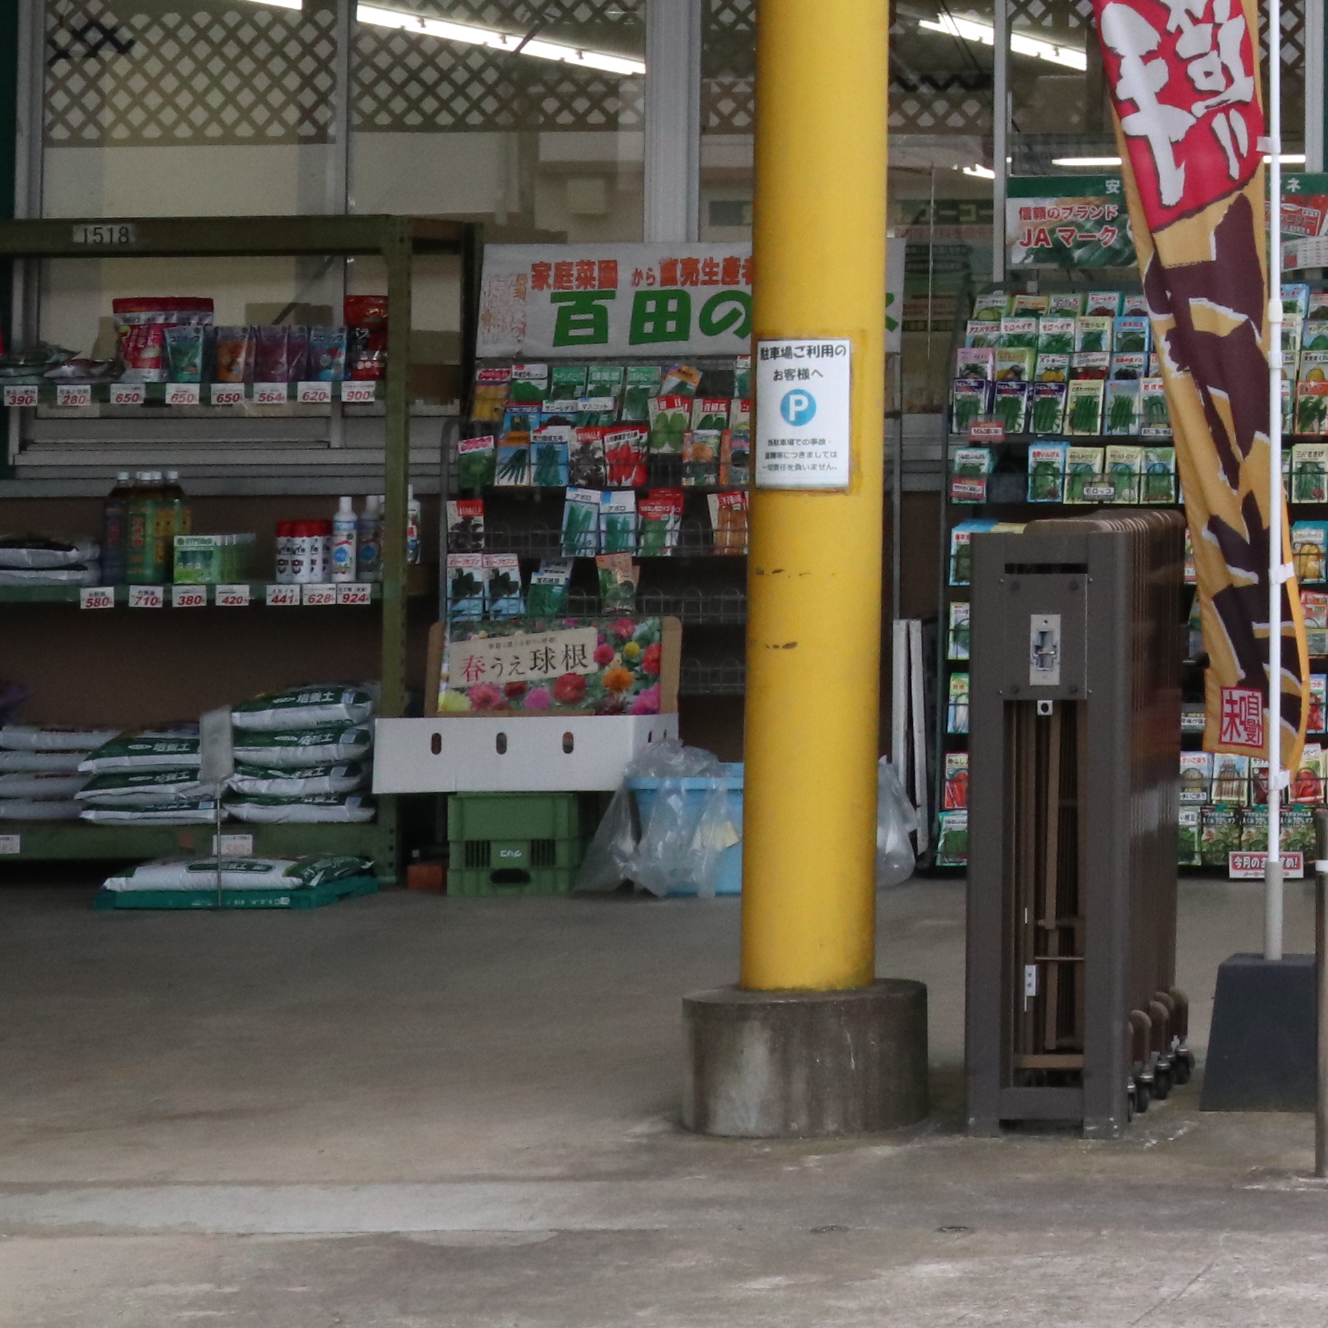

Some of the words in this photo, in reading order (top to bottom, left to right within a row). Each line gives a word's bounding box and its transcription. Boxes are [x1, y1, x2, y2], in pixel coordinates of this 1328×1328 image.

[1019, 205, 1119, 221] 信頼のブランド
[83, 227, 130, 244] 1518
[531, 260, 618, 291] 家庭菜園
[760, 344, 847, 360] 駐車場ご利用の
[773, 367, 824, 382] お客様へ
[461, 643, 589, 682] 春うえ球根
